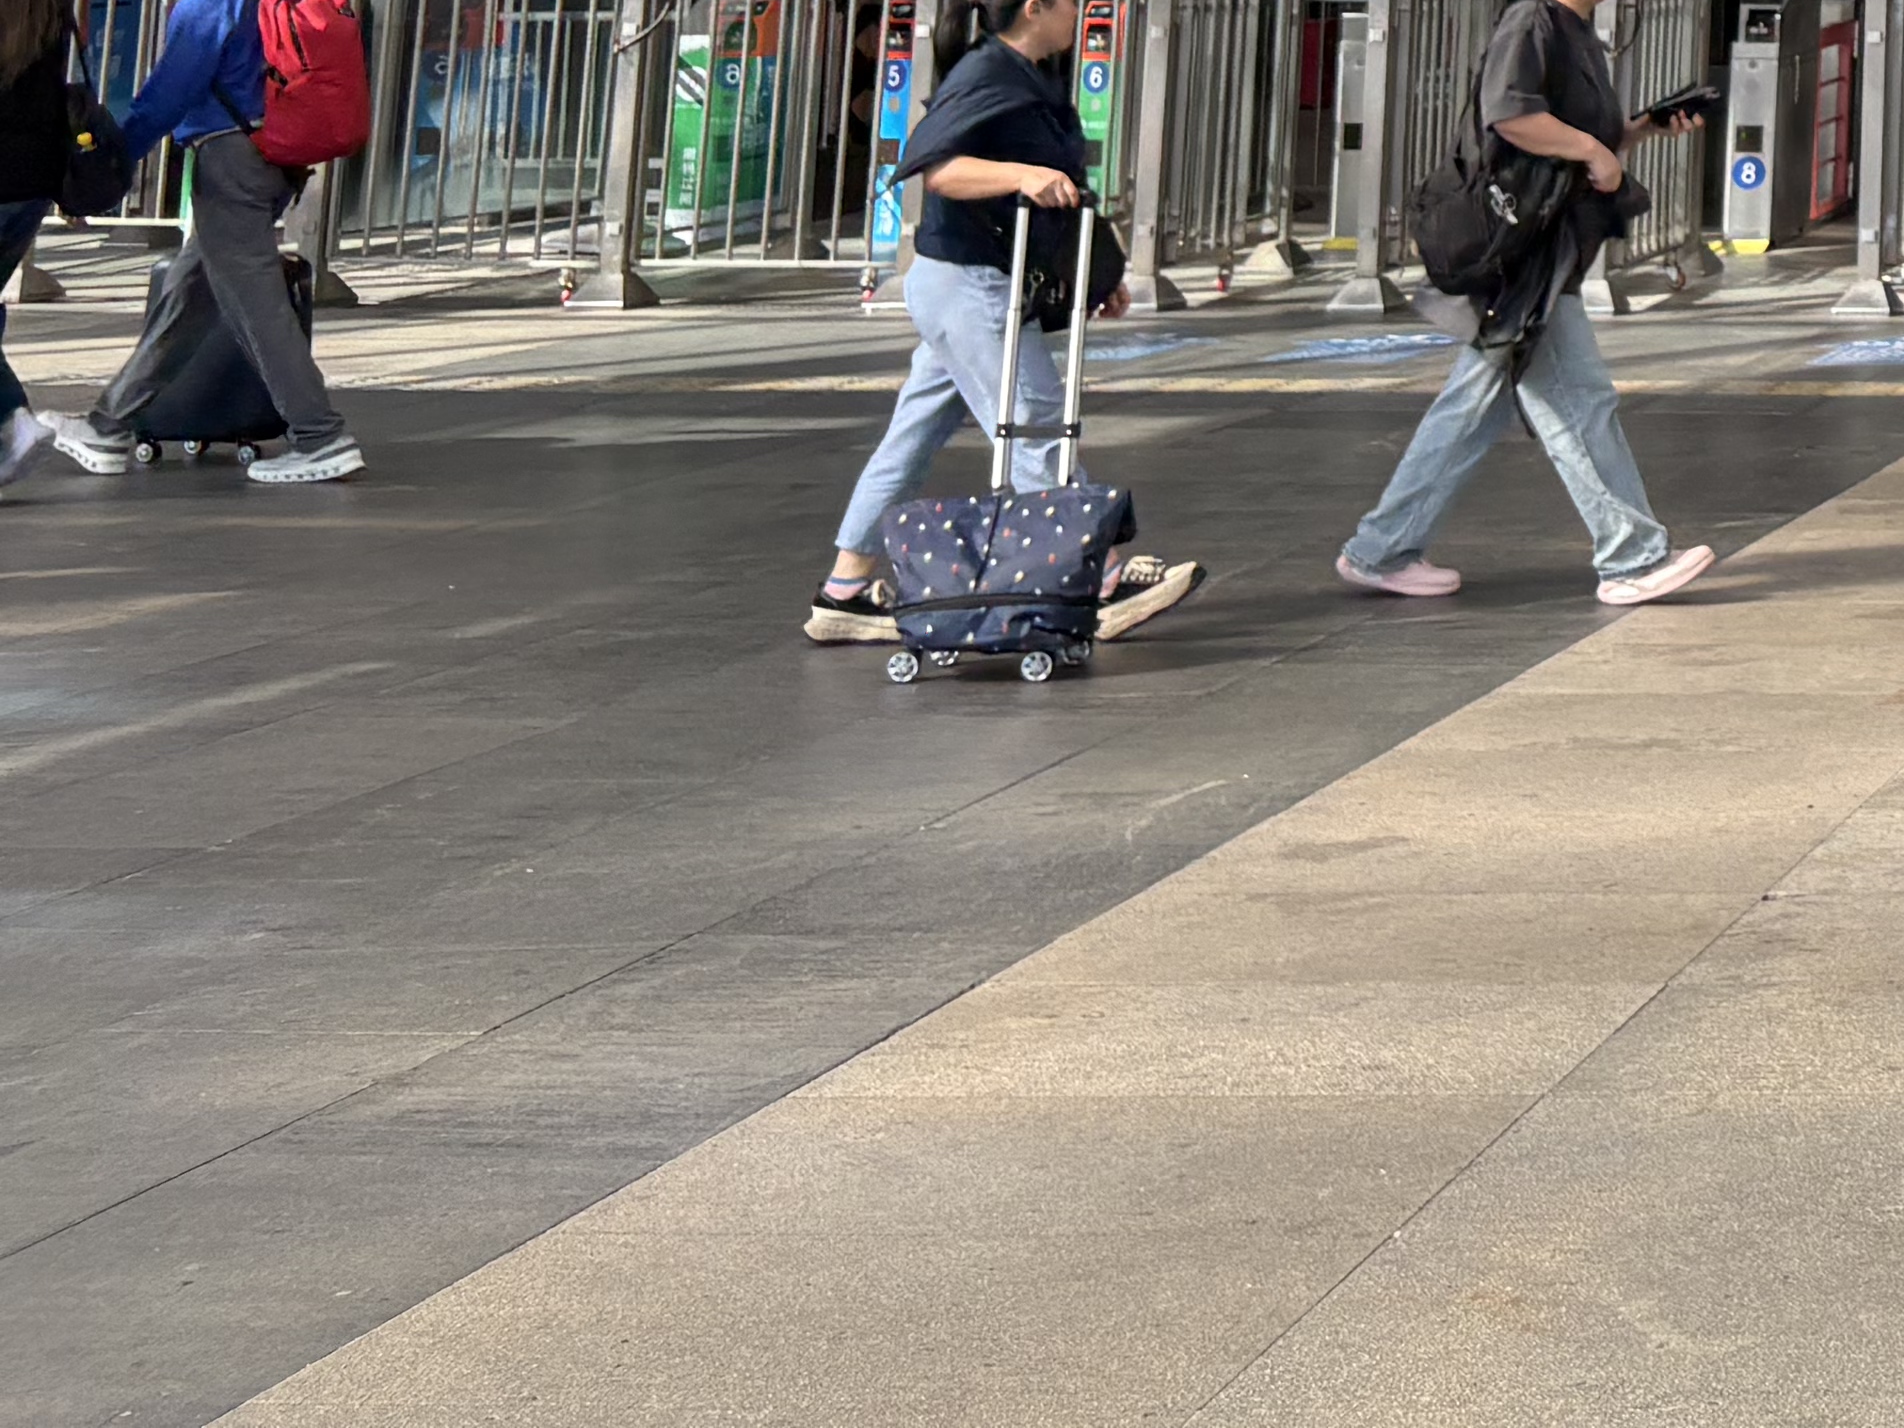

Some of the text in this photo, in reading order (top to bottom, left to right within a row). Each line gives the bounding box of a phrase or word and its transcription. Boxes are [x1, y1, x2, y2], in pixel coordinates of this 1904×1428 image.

[888, 65, 900, 87] 5
[1089, 66, 1102, 87] 6
[1741, 162, 1756, 184] 8
